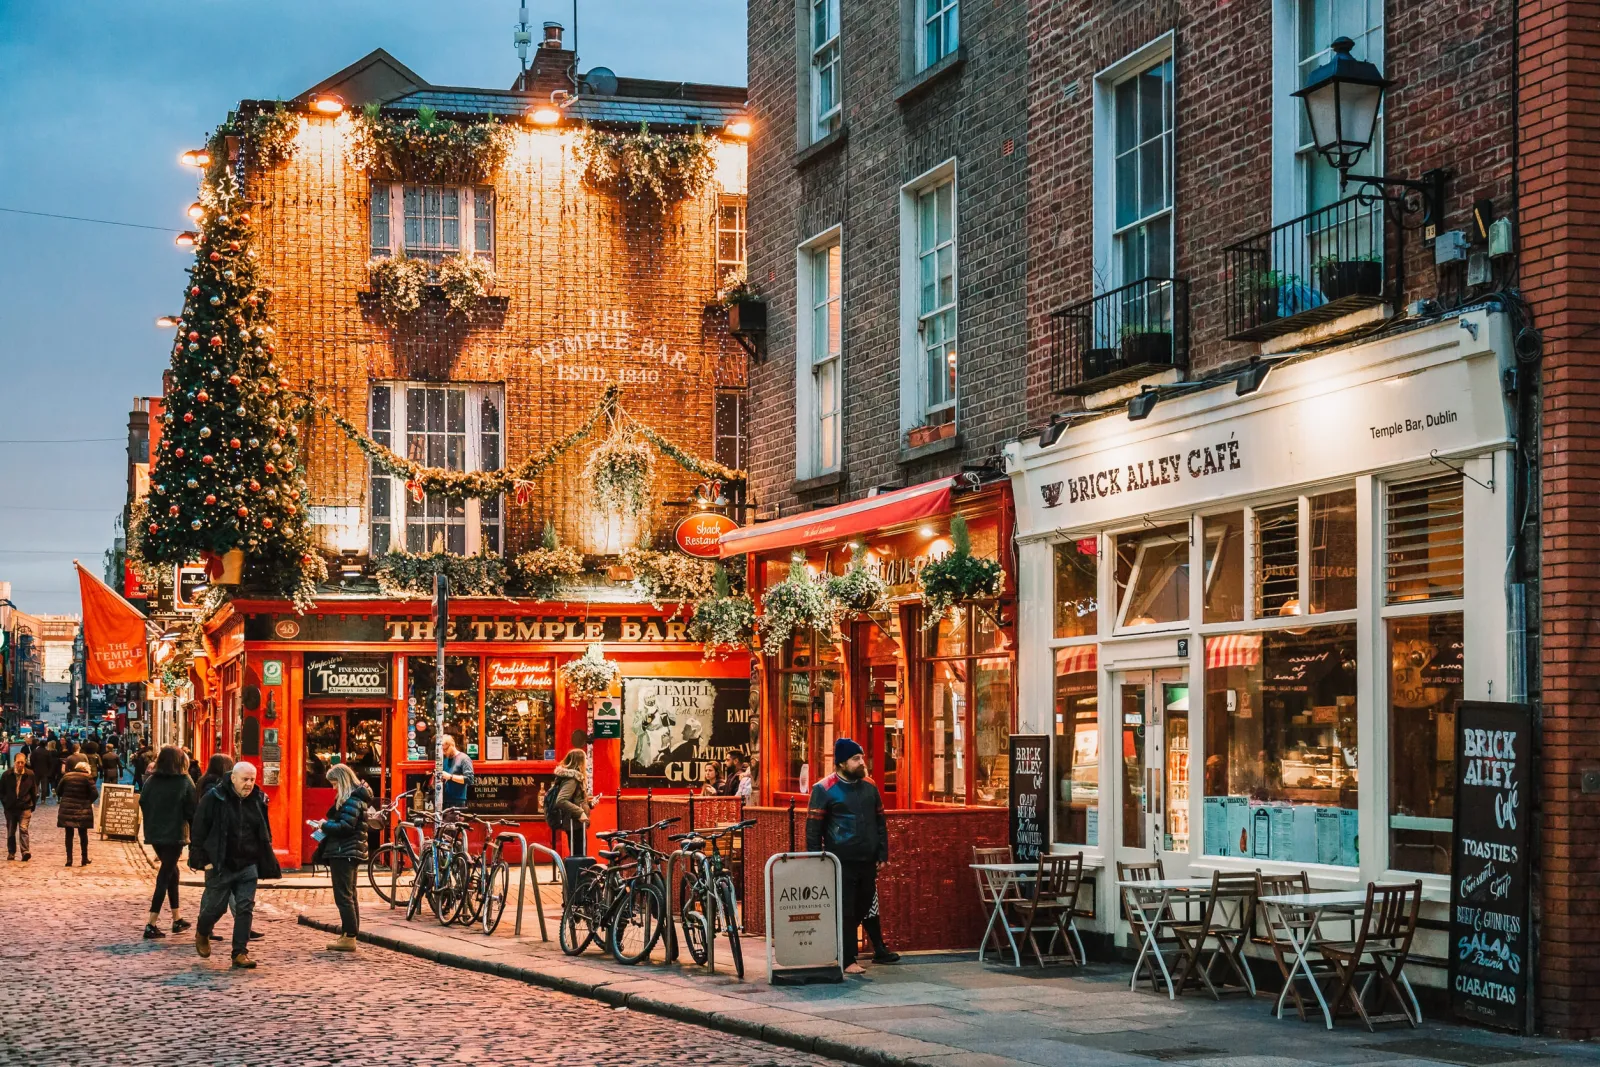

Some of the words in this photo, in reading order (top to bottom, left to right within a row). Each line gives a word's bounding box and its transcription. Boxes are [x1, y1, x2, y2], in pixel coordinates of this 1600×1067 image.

[587, 309, 634, 329] THE
[531, 332, 630, 365] TEMPLE
[641, 337, 687, 371] BAR
[1370, 422, 1403, 439] Temple
[1405, 419, 1424, 431] Bar,
[1426, 410, 1458, 427] Dublin
[1068, 468, 1122, 503] BRICK
[1127, 454, 1181, 492] ALLEY
[1187, 431, 1240, 478] CAFÉ
[696, 521, 721, 535] Shack
[280, 623, 295, 634] 48
[385, 621, 458, 641] THE
[471, 621, 605, 641] TEMPLE
[620, 621, 688, 641] BAR
[94, 648, 143, 662] TEMPLE
[108, 642, 129, 651] THE
[108, 659, 134, 670] BAR
[307, 656, 343, 671] Importers
[492, 661, 549, 674] Traditional
[317, 670, 380, 691] TOBACCO
[490, 674, 517, 686] Irish
[521, 674, 552, 686] Music
[655, 685, 712, 696] TEMPLE
[672, 697, 699, 708] BAR
[1464, 728, 1517, 760] BRICK
[1016, 747, 1041, 761] BRICK
[1015, 761, 1042, 774] ALLEY
[1463, 759, 1516, 789] ALLEY
[512, 777, 535, 786] BAR
[1019, 793, 1037, 807] CRAFT
[1495, 781, 1519, 830] Café
[1462, 839, 1518, 863] TOASTIES
[780, 885, 830, 902] ARIOSA
[1483, 911, 1521, 934] GUINNESS
[1458, 932, 1521, 975] SALADS
[1472, 950, 1504, 971] Paninis
[1455, 974, 1517, 1005] CIABATTAS
